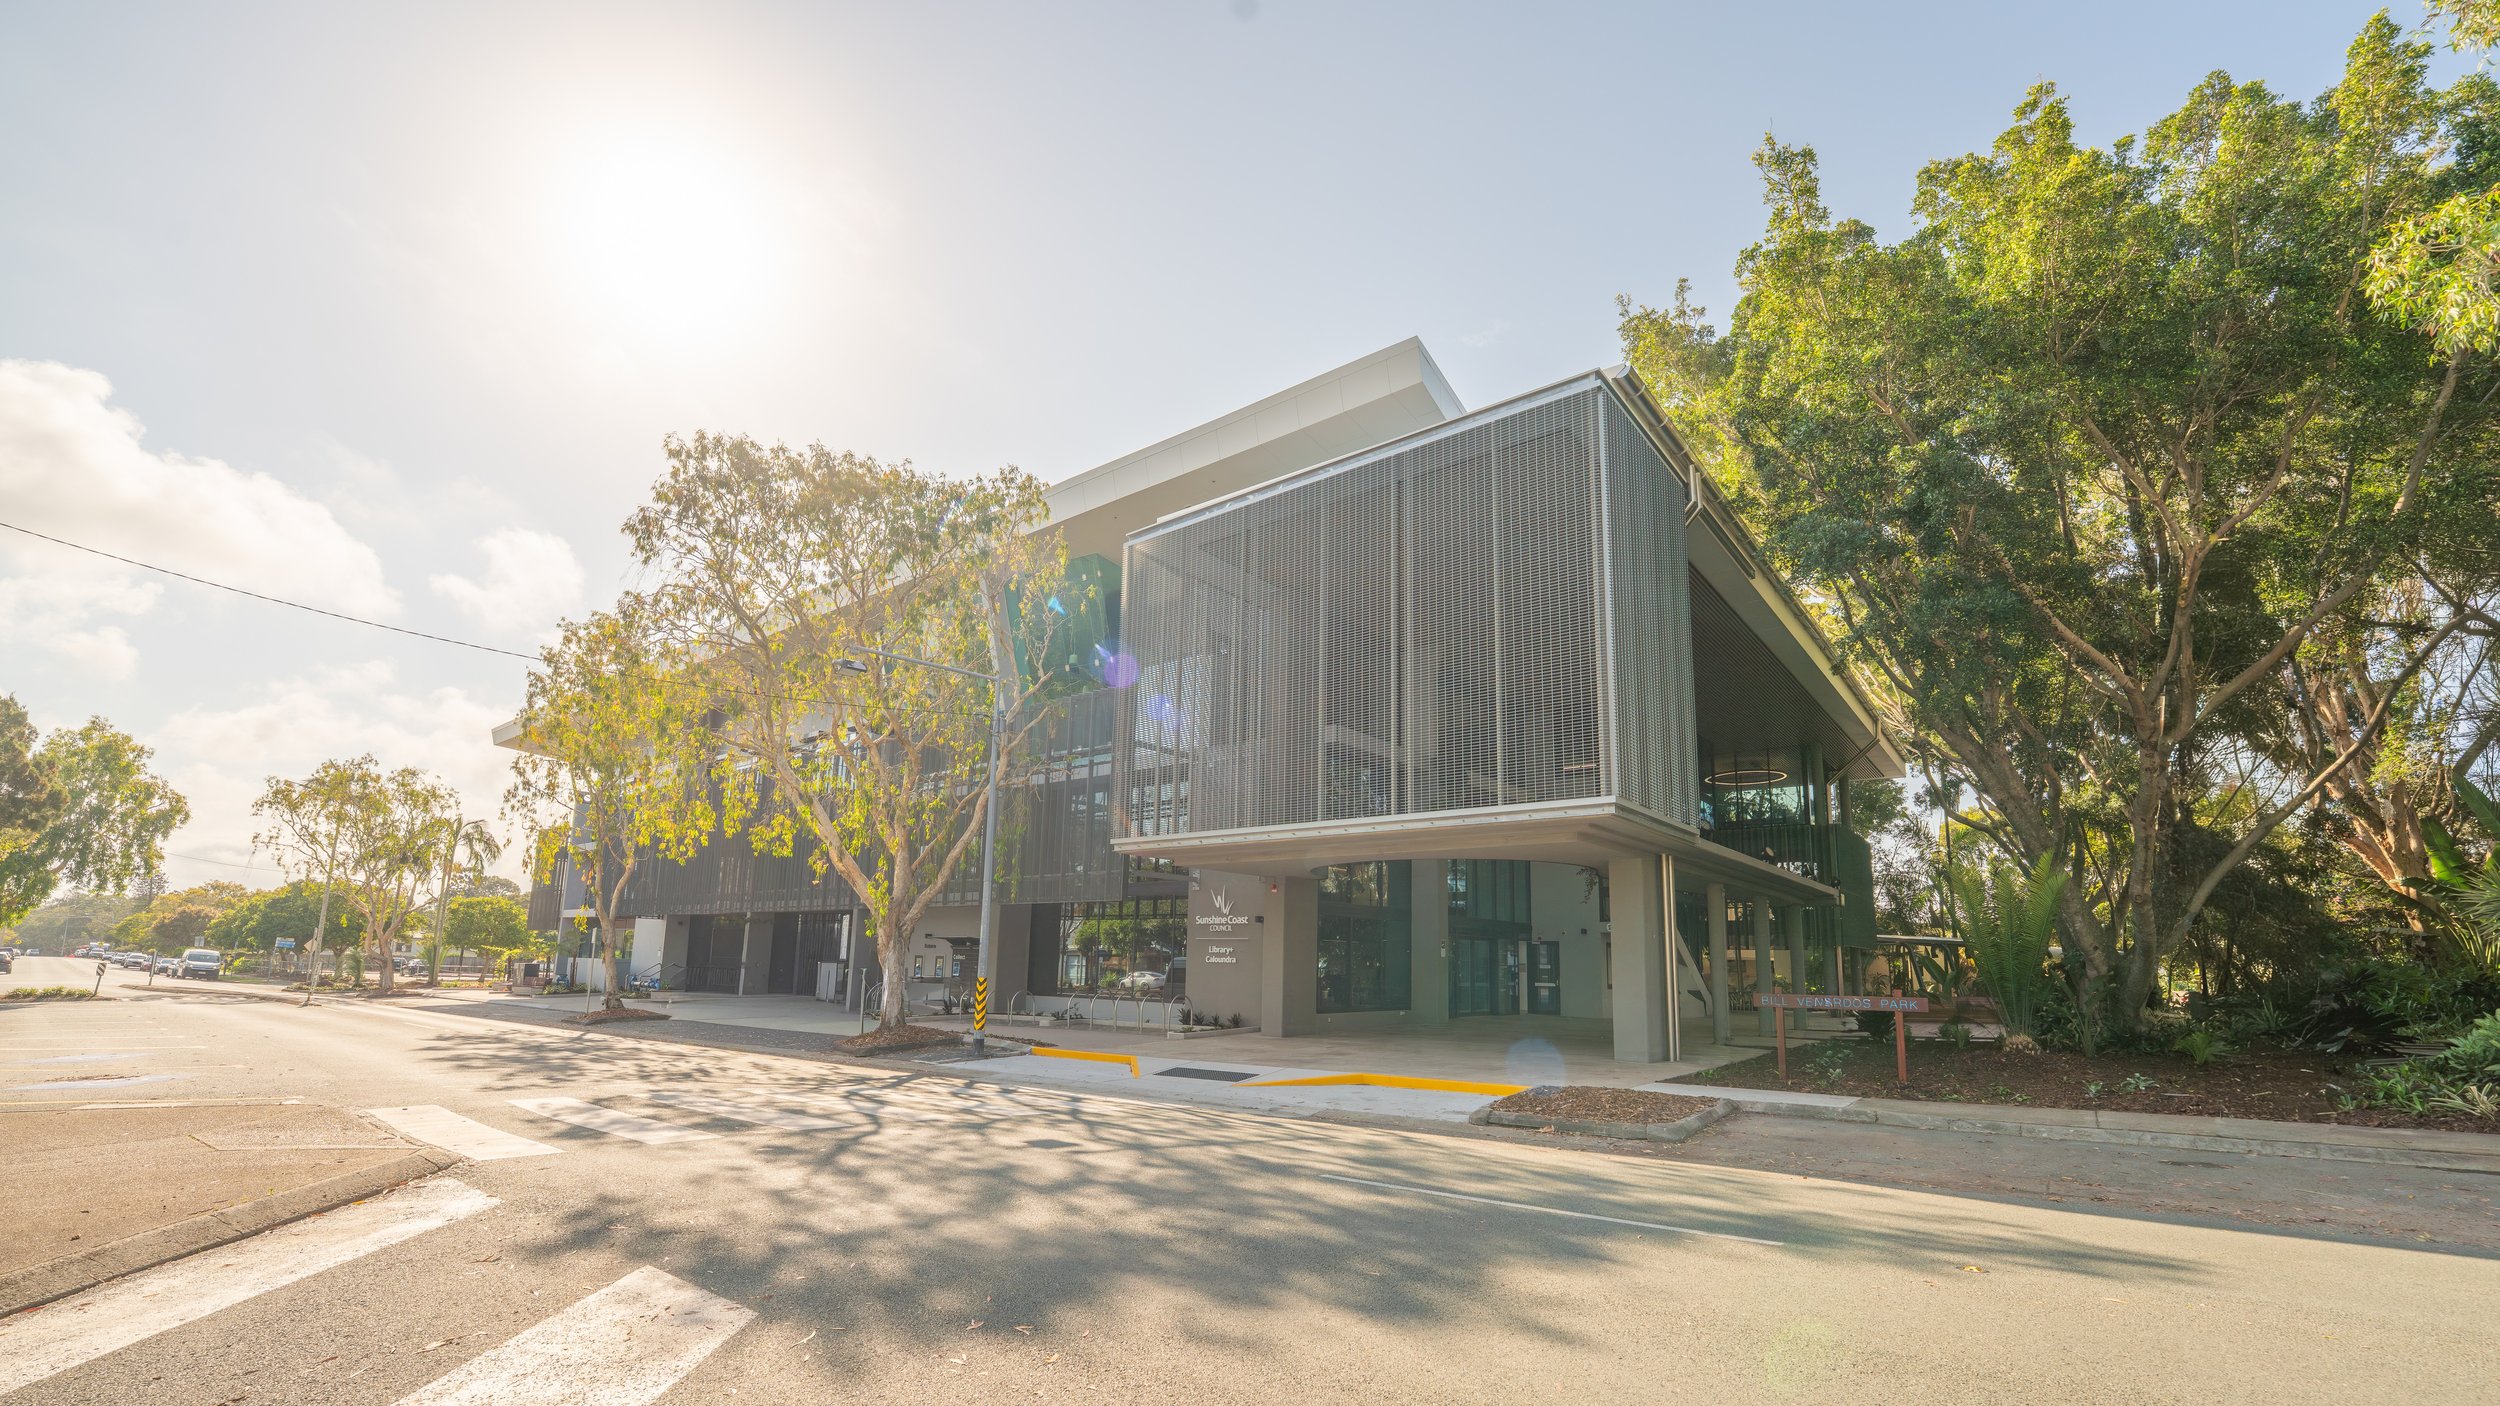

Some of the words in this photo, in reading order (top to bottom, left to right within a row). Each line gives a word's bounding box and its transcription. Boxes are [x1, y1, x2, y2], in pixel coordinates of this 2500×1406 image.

[1195, 915, 1227, 924] Sunshine
[1227, 915, 1248, 924] Coast
[1208, 945, 1234, 955] Library+
[1205, 955, 1236, 963] Caloundra
[1761, 995, 1788, 1006] BILL
[1880, 999, 1918, 1010] PARK
